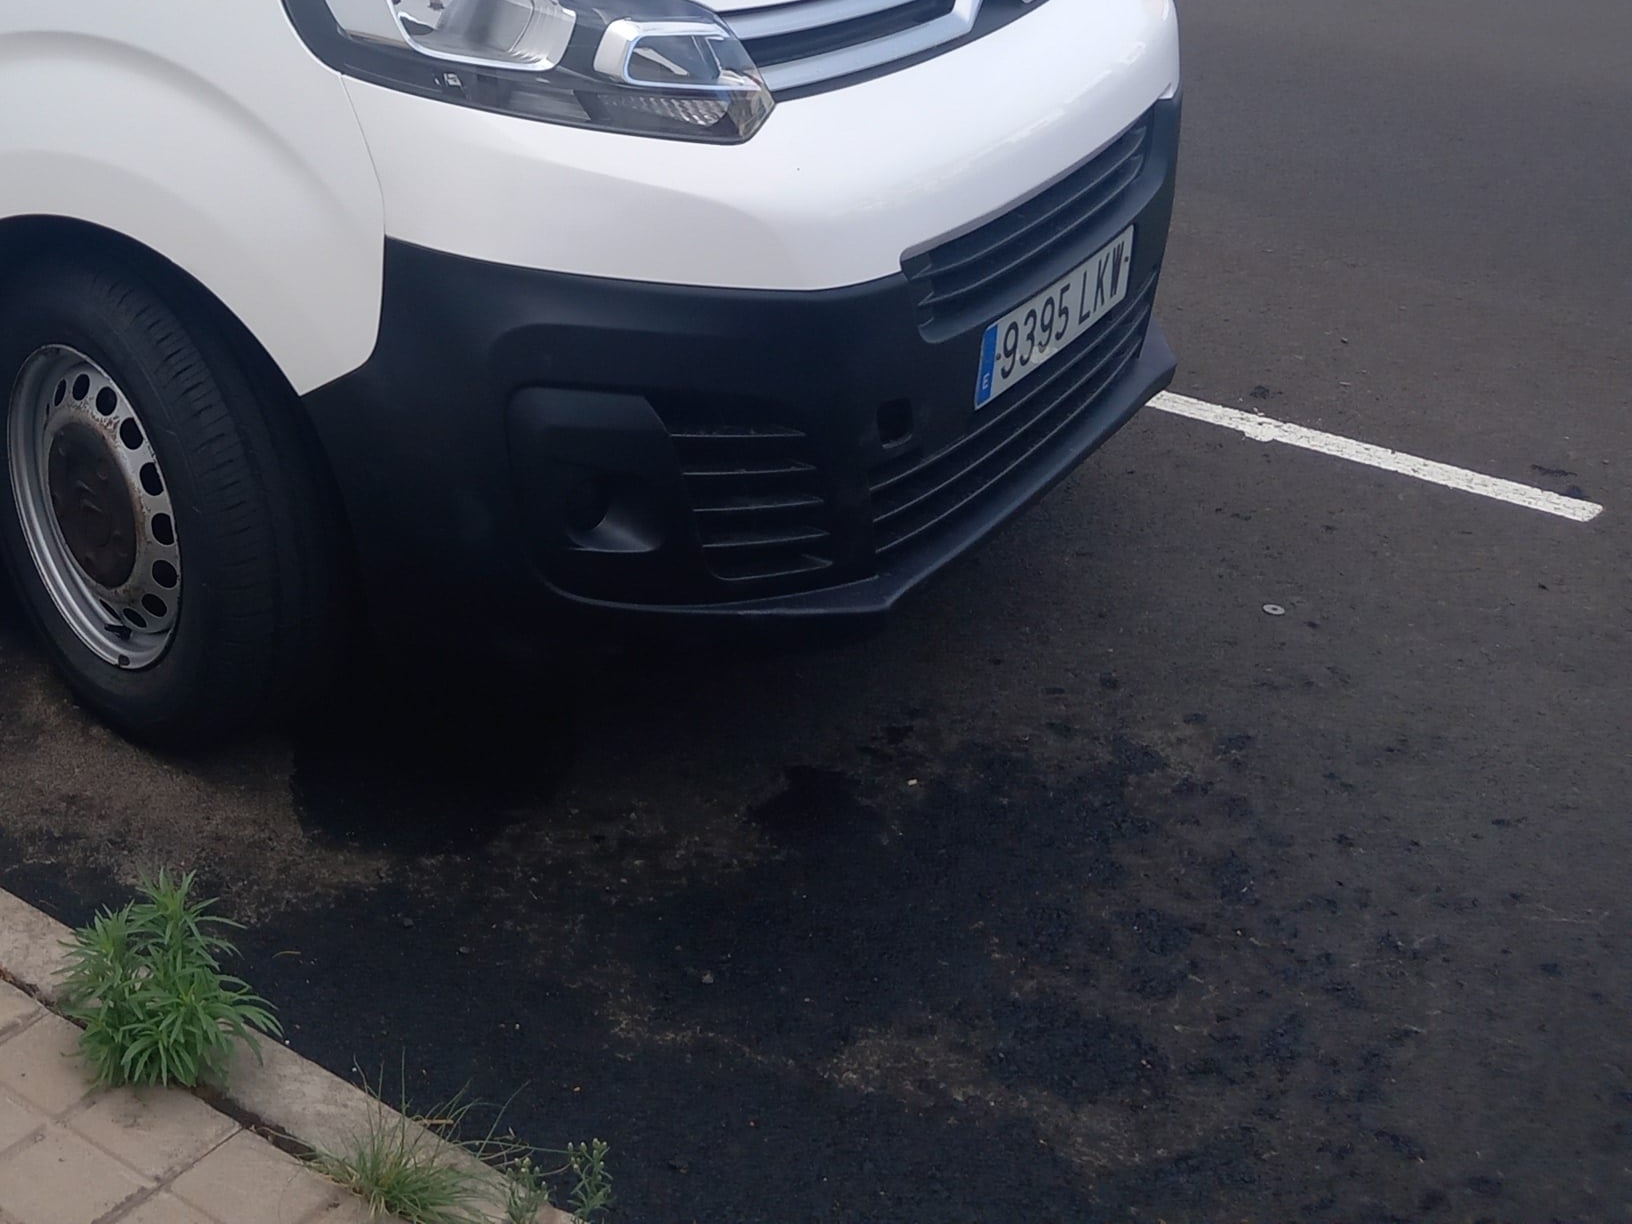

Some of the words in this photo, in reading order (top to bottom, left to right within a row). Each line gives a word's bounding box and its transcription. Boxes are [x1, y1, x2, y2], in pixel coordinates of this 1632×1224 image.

[1000, 283, 1071, 380] 9395
[1078, 240, 1125, 325] LKW
[982, 372, 990, 391] E
